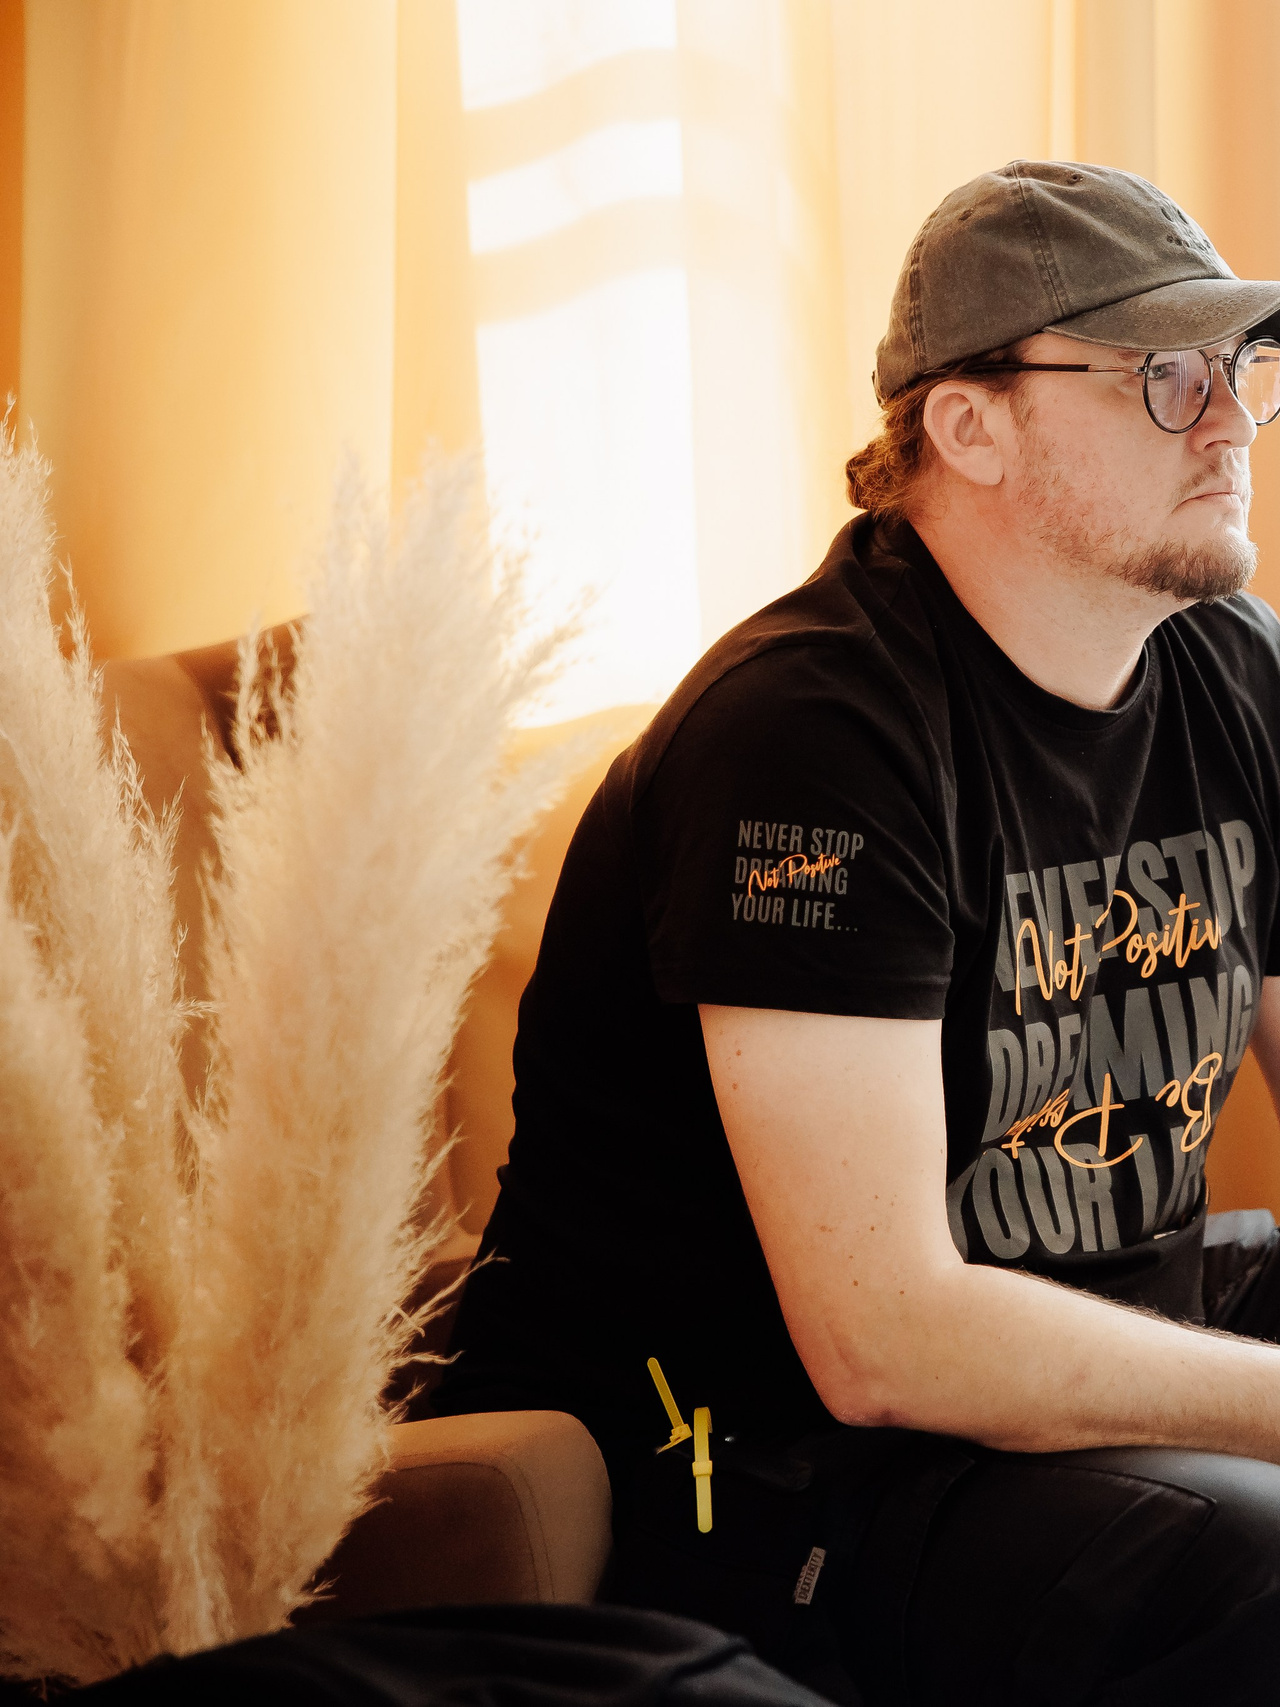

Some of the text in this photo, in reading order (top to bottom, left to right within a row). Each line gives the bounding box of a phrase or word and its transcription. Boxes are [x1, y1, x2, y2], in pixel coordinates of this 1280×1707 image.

[737, 820, 865, 860] NEVER STOP
[748, 853, 841, 897] Not Positive
[731, 893, 785, 925] YOUR
[1015, 919, 1092, 1016] Not
